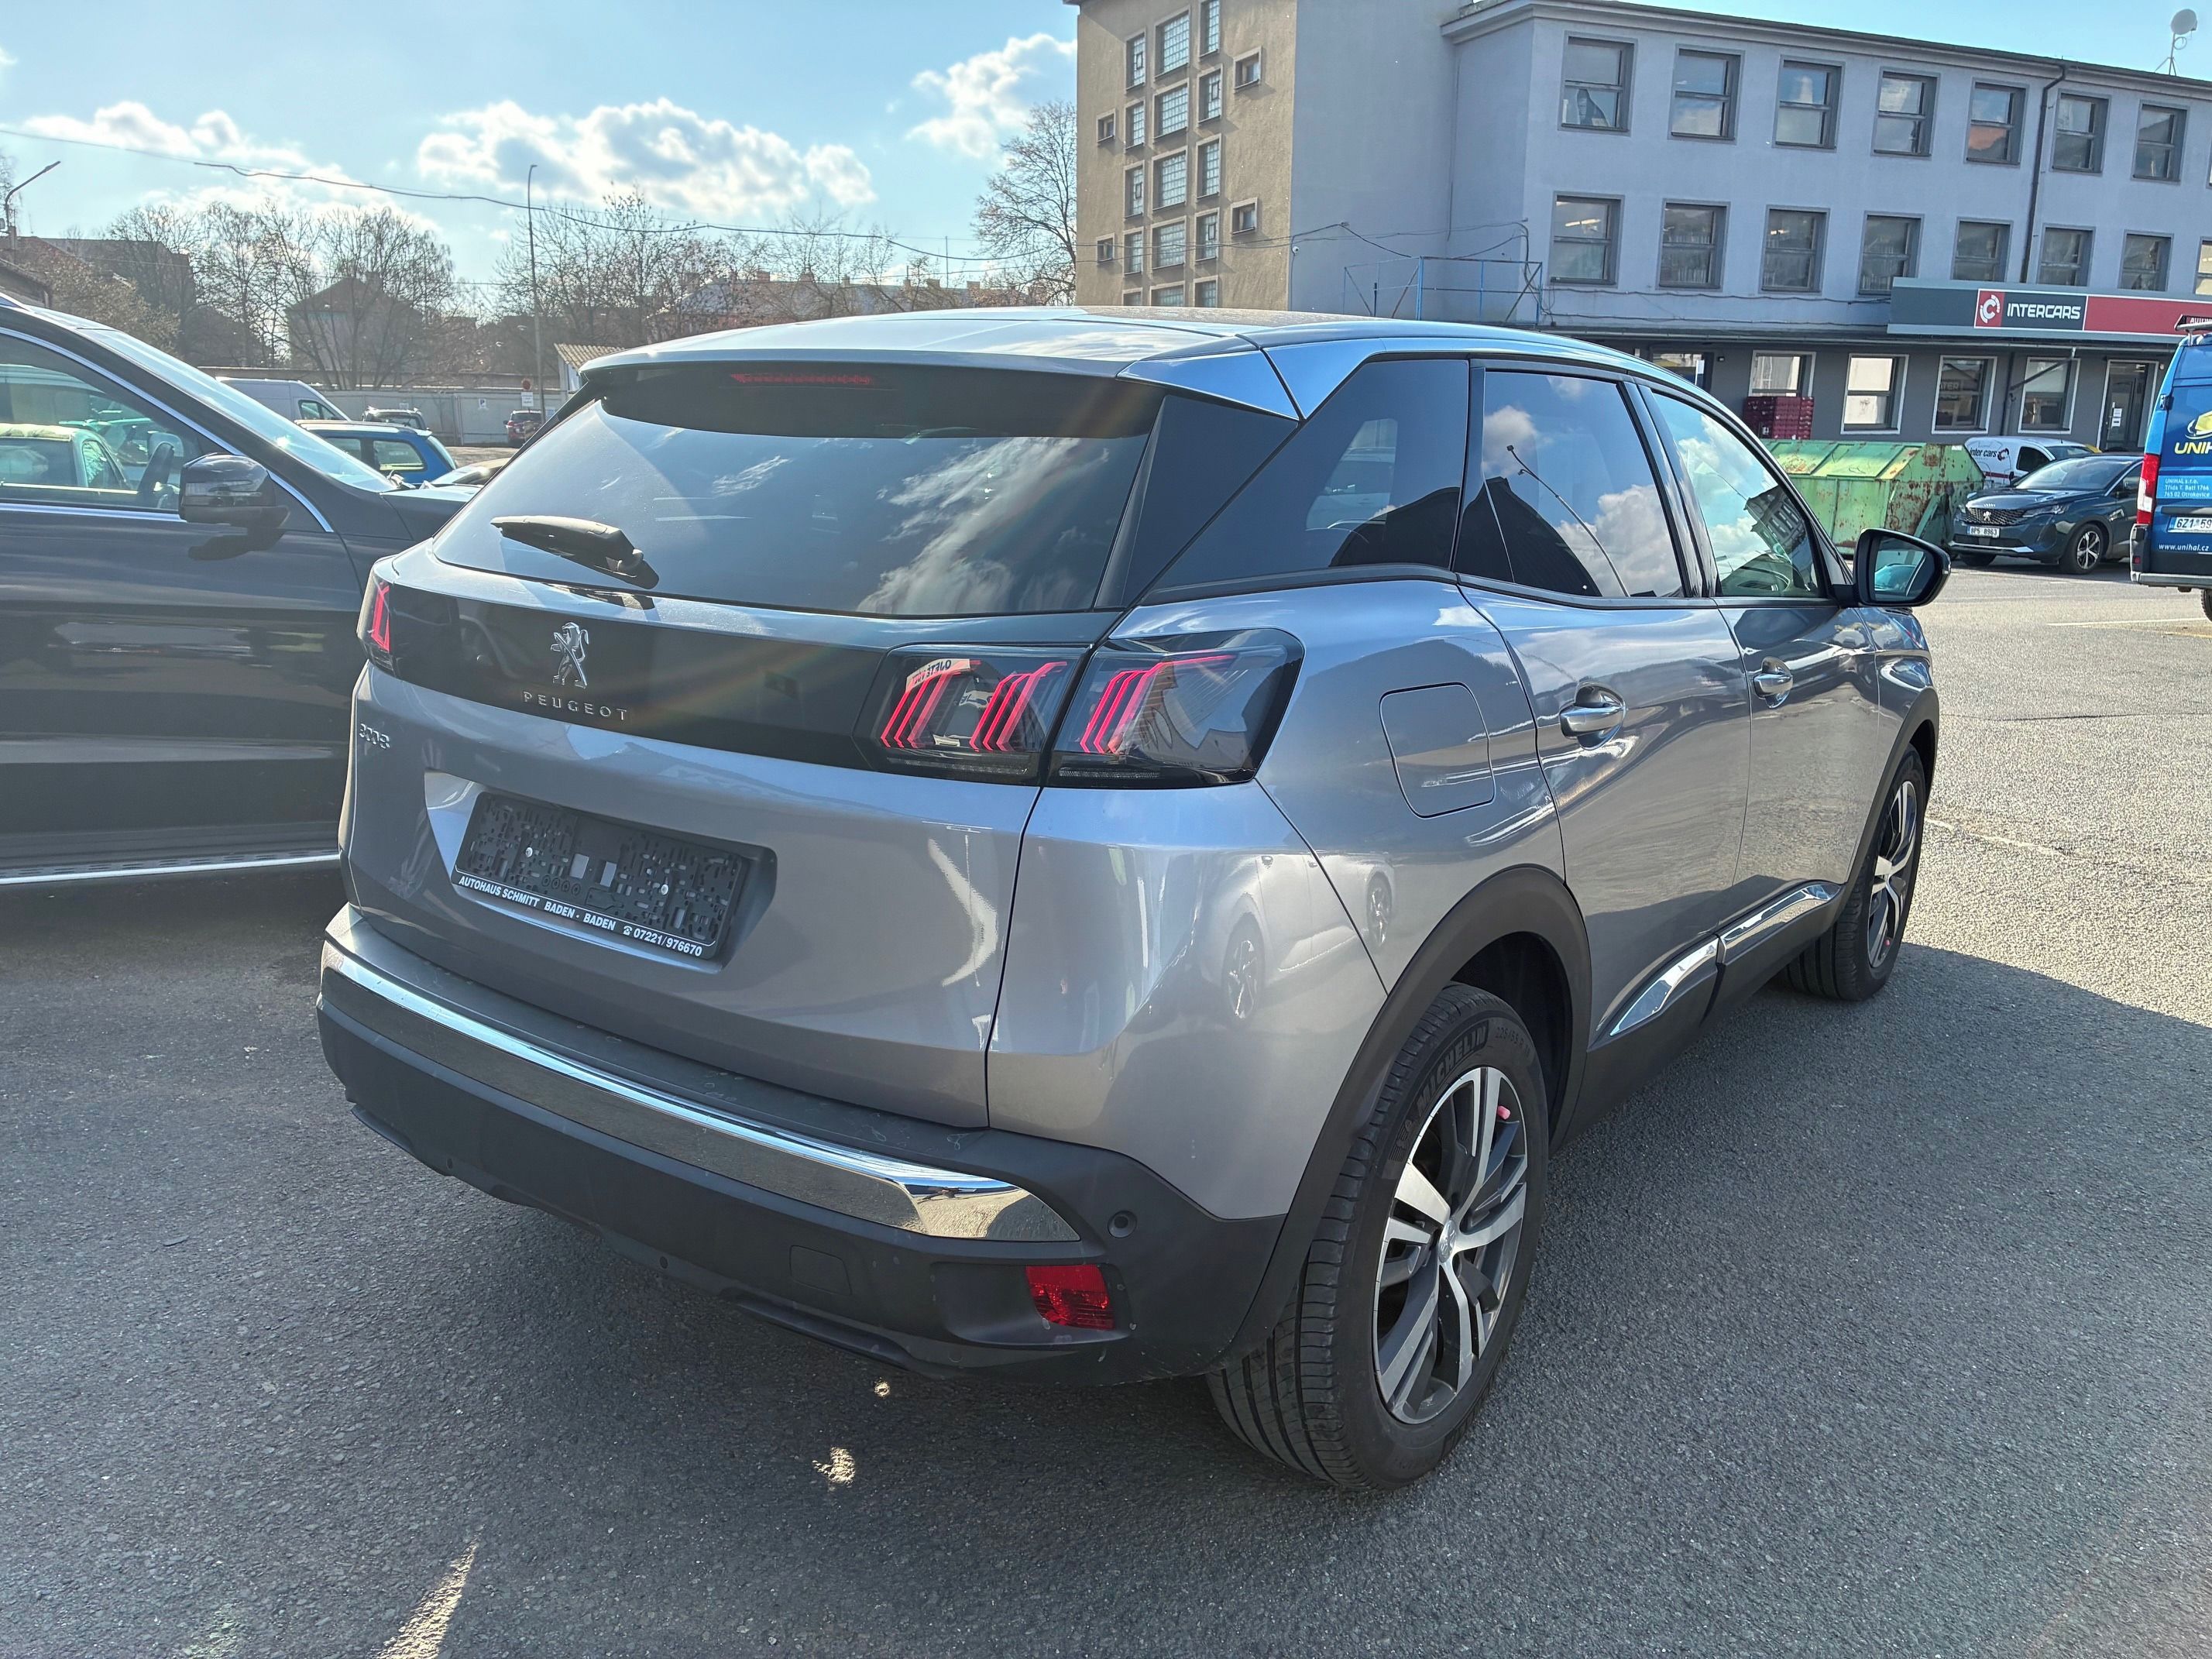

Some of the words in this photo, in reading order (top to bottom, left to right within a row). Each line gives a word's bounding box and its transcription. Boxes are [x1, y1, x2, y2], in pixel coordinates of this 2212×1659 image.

[2007, 303, 2081, 320] INTERCARS
[2176, 518, 2194, 528] 6Z1
[2159, 543, 2210, 551] www.unihal.cz
[523, 691, 627, 720] PEUGEOT
[359, 723, 390, 749] 3008
[459, 876, 502, 896] AUTOHAUS
[502, 888, 540, 907] SCHMITT
[544, 901, 575, 919] BADEN
[582, 912, 617, 931] BADEN
[633, 928, 702, 957] 07221/976670
[1417, 1026, 1487, 1118] MICHELIN
